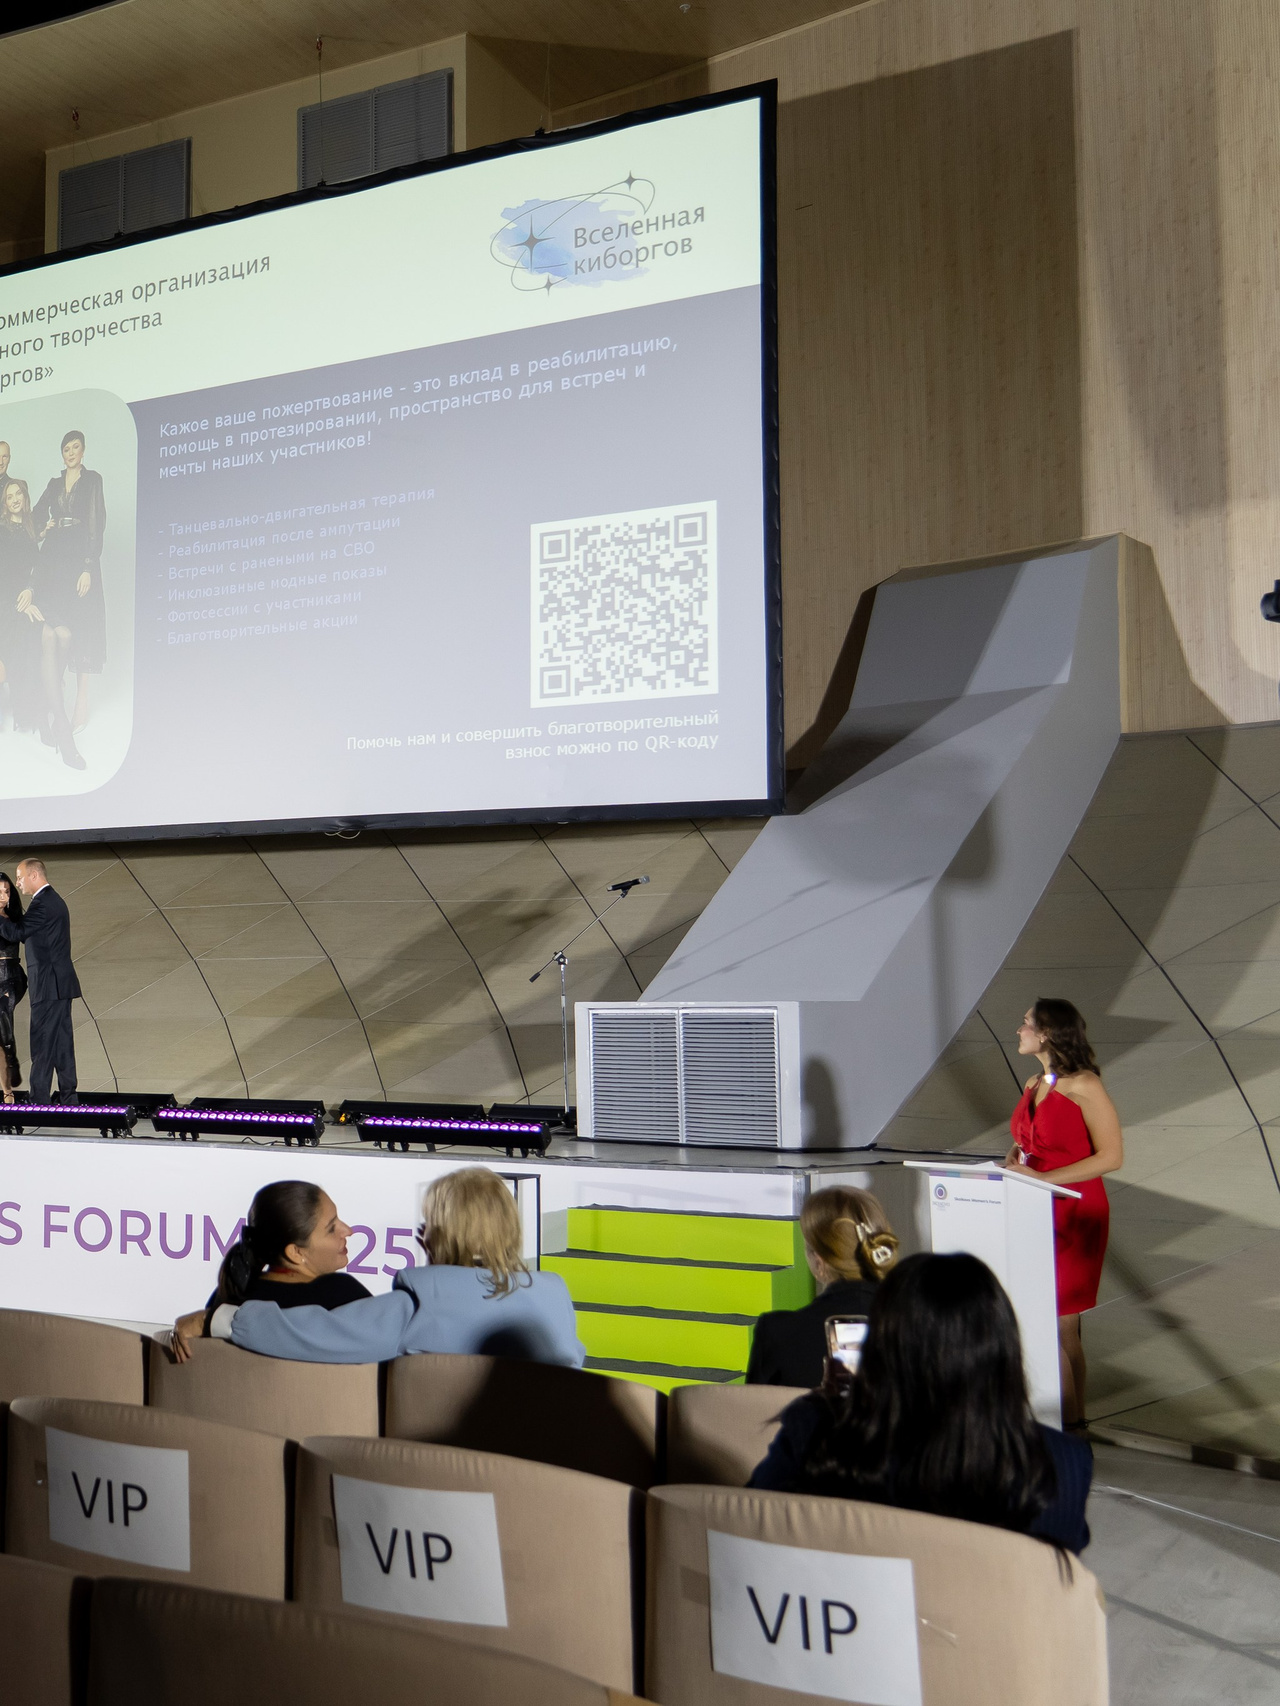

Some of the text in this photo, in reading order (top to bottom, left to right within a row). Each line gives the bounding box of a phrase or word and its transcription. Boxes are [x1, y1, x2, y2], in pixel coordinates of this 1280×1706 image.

[573, 206, 706, 249] Вселенная
[574, 236, 694, 276] киборгов
[131, 255, 272, 305] организация
[50, 310, 163, 349] творчества
[159, 415, 210, 440] Кажое
[214, 408, 257, 430] ваше
[261, 382, 394, 421] пожертвование
[412, 374, 442, 394] это
[448, 363, 503, 388] вклад
[509, 361, 521, 377] в
[527, 334, 679, 378] реабилитацию,
[159, 360, 646, 459] помощь в протезировании, пространство для встреч и
[159, 430, 373, 480] мечты наших участников!
[170, 497, 366, 536] Танцевально-двигательная
[372, 488, 436, 508] терапия
[168, 534, 266, 558] Реабилитация
[272, 526, 314, 543] после
[320, 516, 401, 537] ампутации
[168, 562, 224, 580] Встречи
[242, 548, 315, 573] ранеными
[320, 547, 337, 560] на
[344, 540, 376, 558] СВО
[168, 580, 266, 602] Инклюзивные
[270, 570, 328, 589] модные
[333, 564, 387, 582] показы
[167, 604, 248, 624] Фотосессии
[266, 589, 362, 612] участниками
[166, 618, 308, 645] Благотворительные
[313, 612, 358, 630] акции
[346, 710, 719, 750] Помочь нам и совершить благотворительный
[505, 734, 719, 760] взнос можно по QR-коду
[42, 1204, 249, 1261] FORUM
[71, 1470, 149, 1527] VIP
[364, 1521, 453, 1582] VIP
[745, 1584, 859, 1656] VIP
